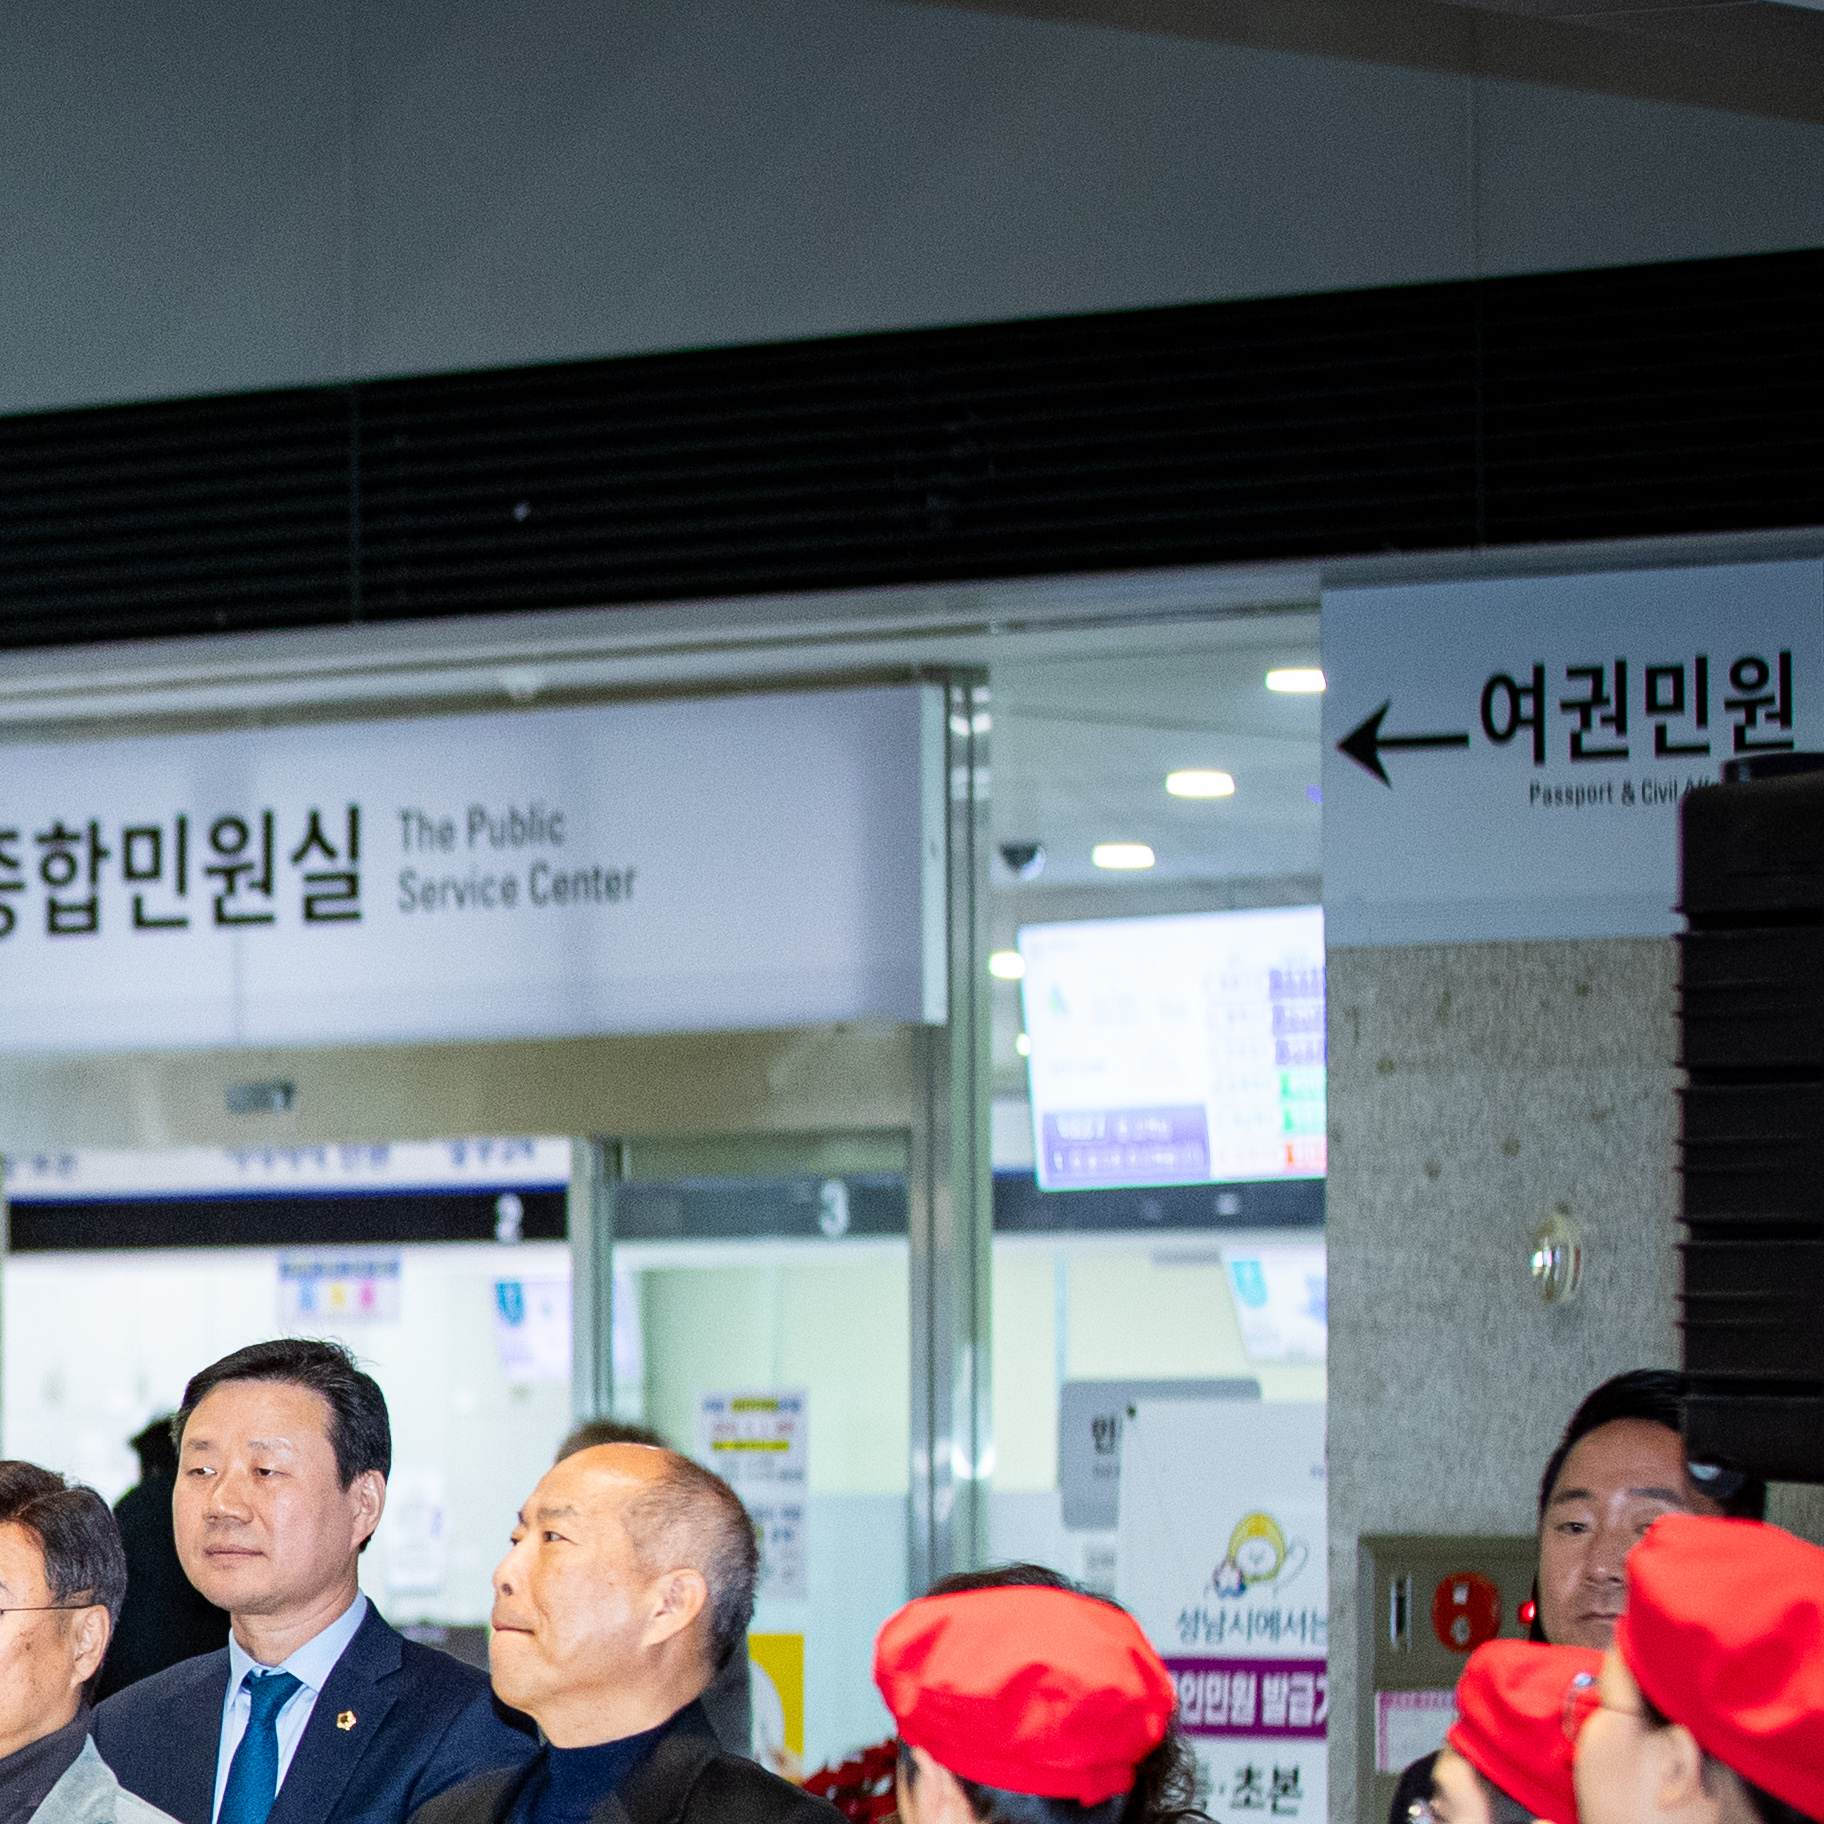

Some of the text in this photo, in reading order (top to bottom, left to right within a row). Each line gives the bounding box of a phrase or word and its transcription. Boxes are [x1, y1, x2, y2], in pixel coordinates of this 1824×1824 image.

[1480, 650, 1795, 767] 여권민원
[1529, 780, 1614, 808] Passport
[1623, 778, 1635, 804] &
[1642, 775, 1678, 803] Civil
[398, 803, 566, 850] The Public
[399, 860, 636, 912] Service Center
[1170, 1670, 1255, 1729] 인민원
